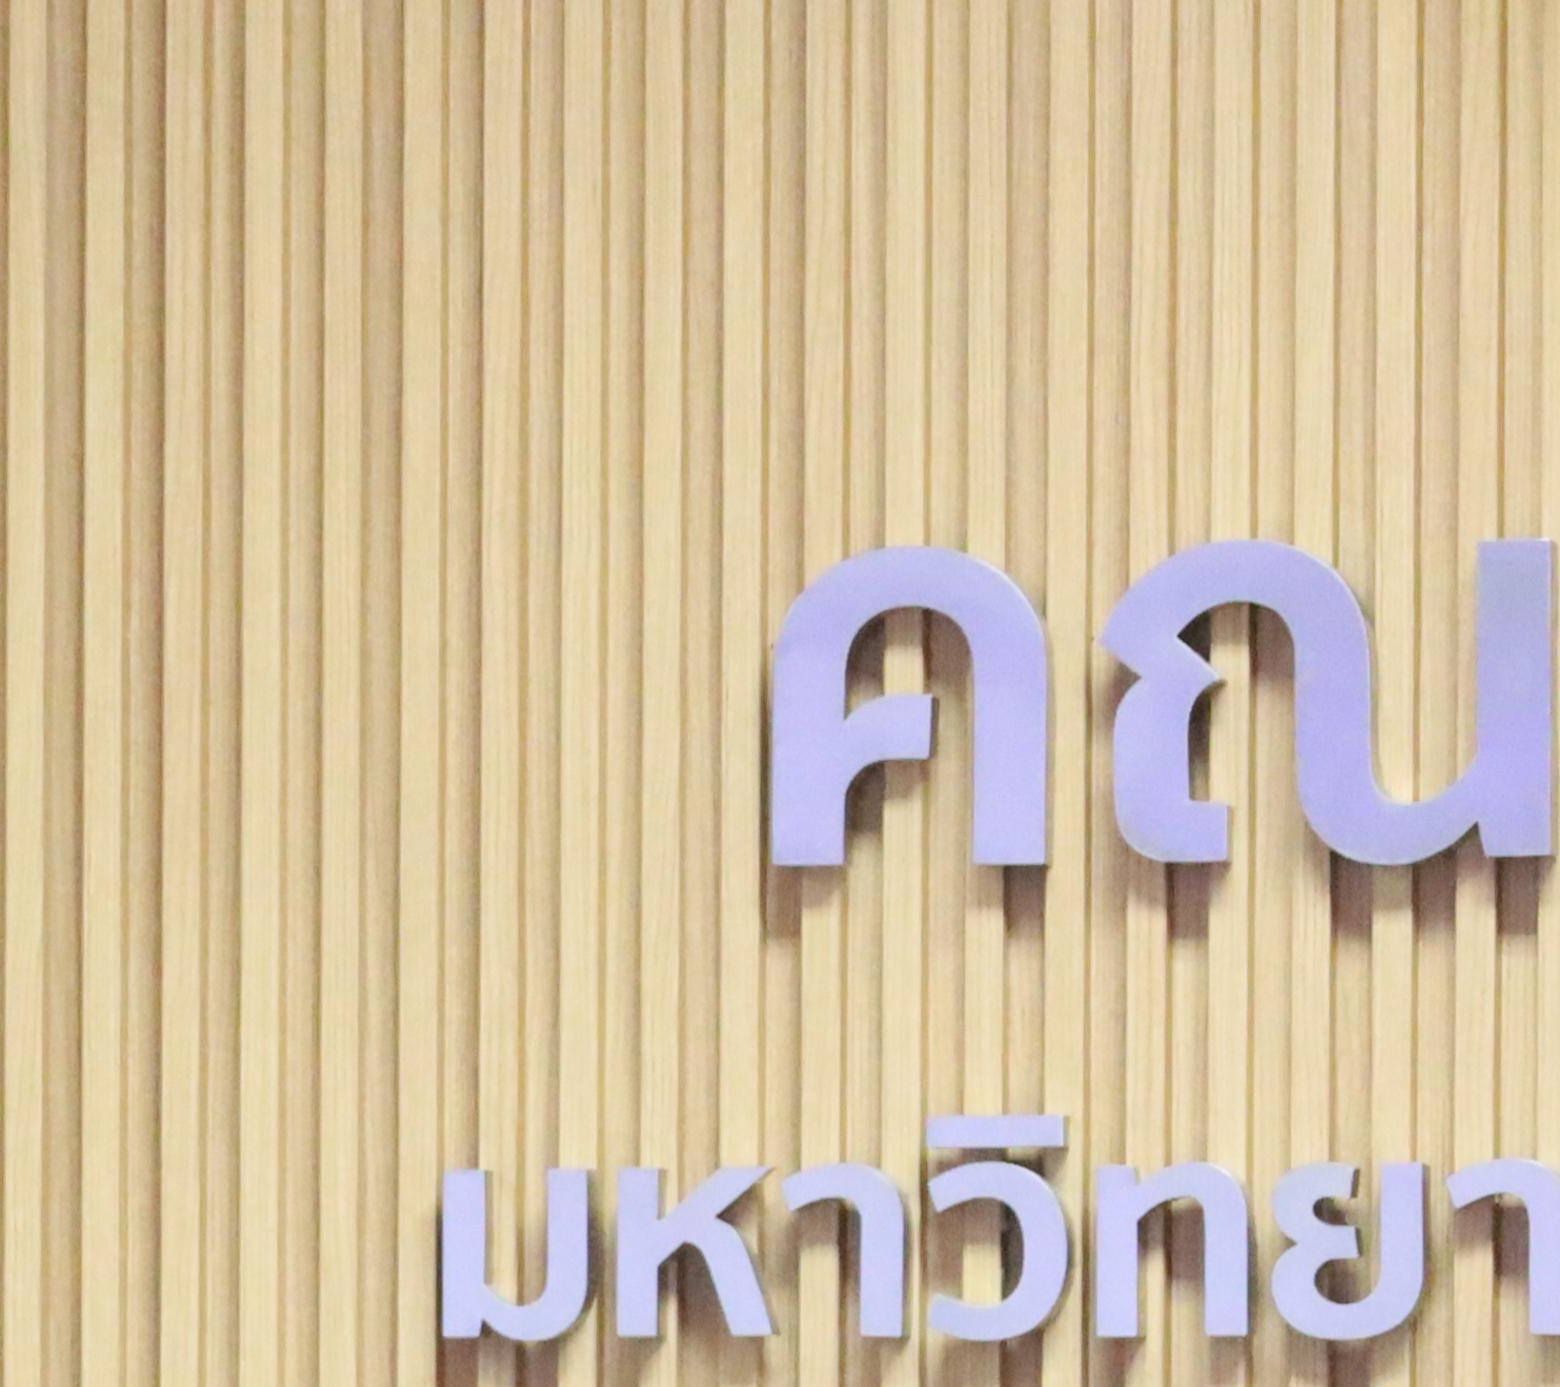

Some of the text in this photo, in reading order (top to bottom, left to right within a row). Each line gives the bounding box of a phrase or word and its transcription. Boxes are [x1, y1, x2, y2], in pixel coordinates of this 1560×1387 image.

[770, 538, 1553, 866] คณ
[439, 1114, 1560, 1341] มหาวิทยา
